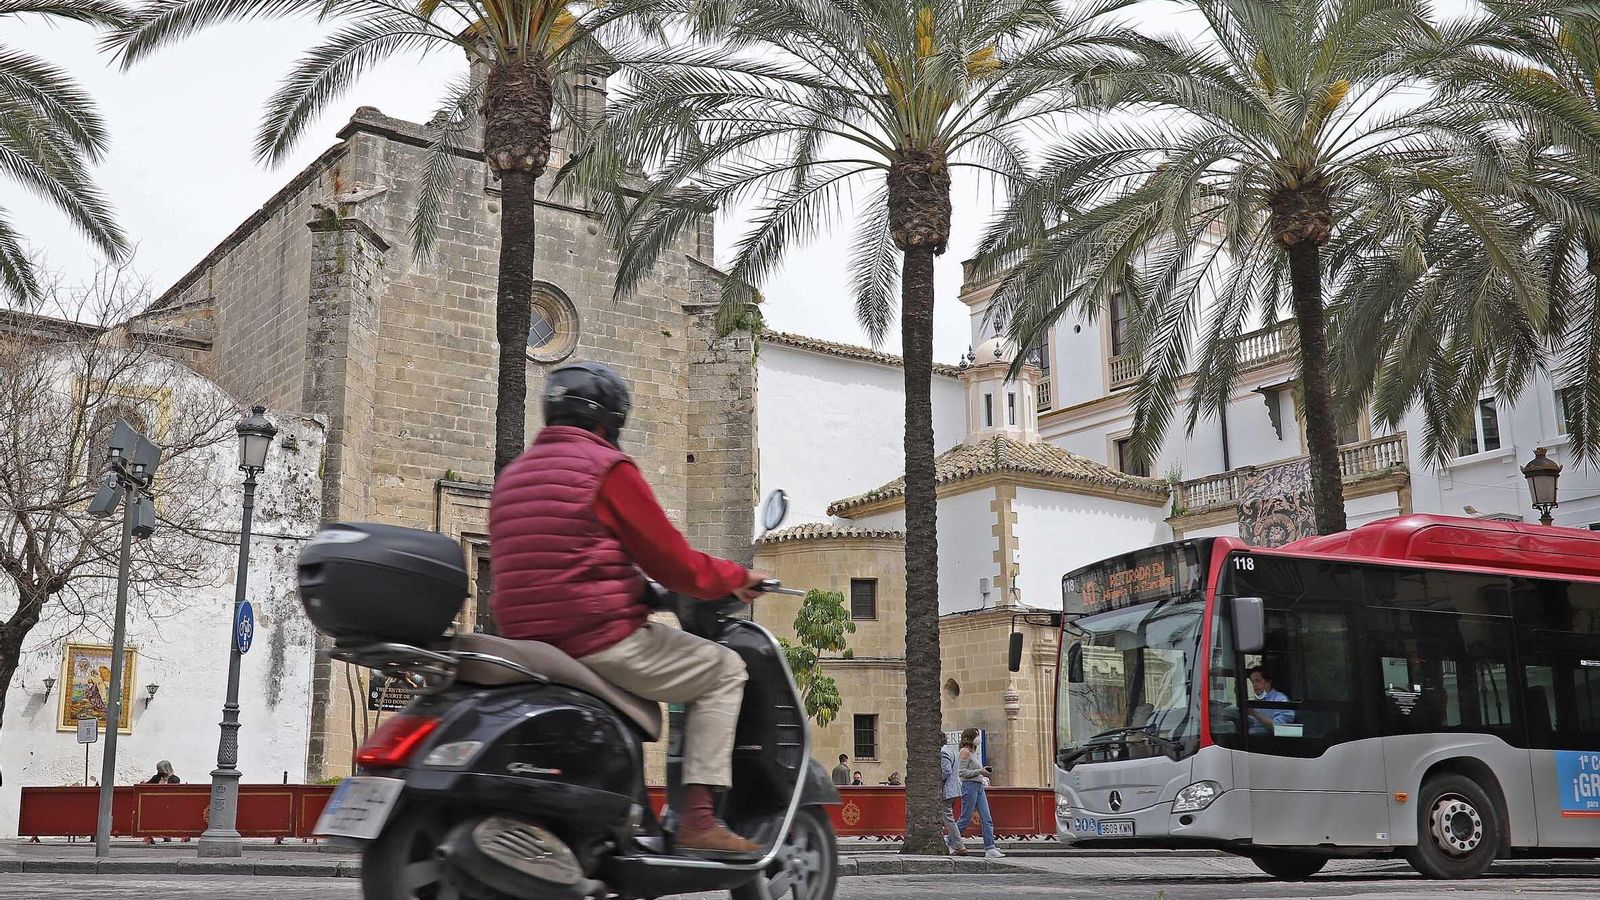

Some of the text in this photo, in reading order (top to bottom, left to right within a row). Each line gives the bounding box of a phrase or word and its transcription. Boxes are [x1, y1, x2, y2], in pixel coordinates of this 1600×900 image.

[1233, 556, 1255, 571] 118
[1063, 580, 1075, 593] 118
[1572, 773, 1600, 802] ¡GR
[1102, 822, 1132, 834] 9609 KWN
